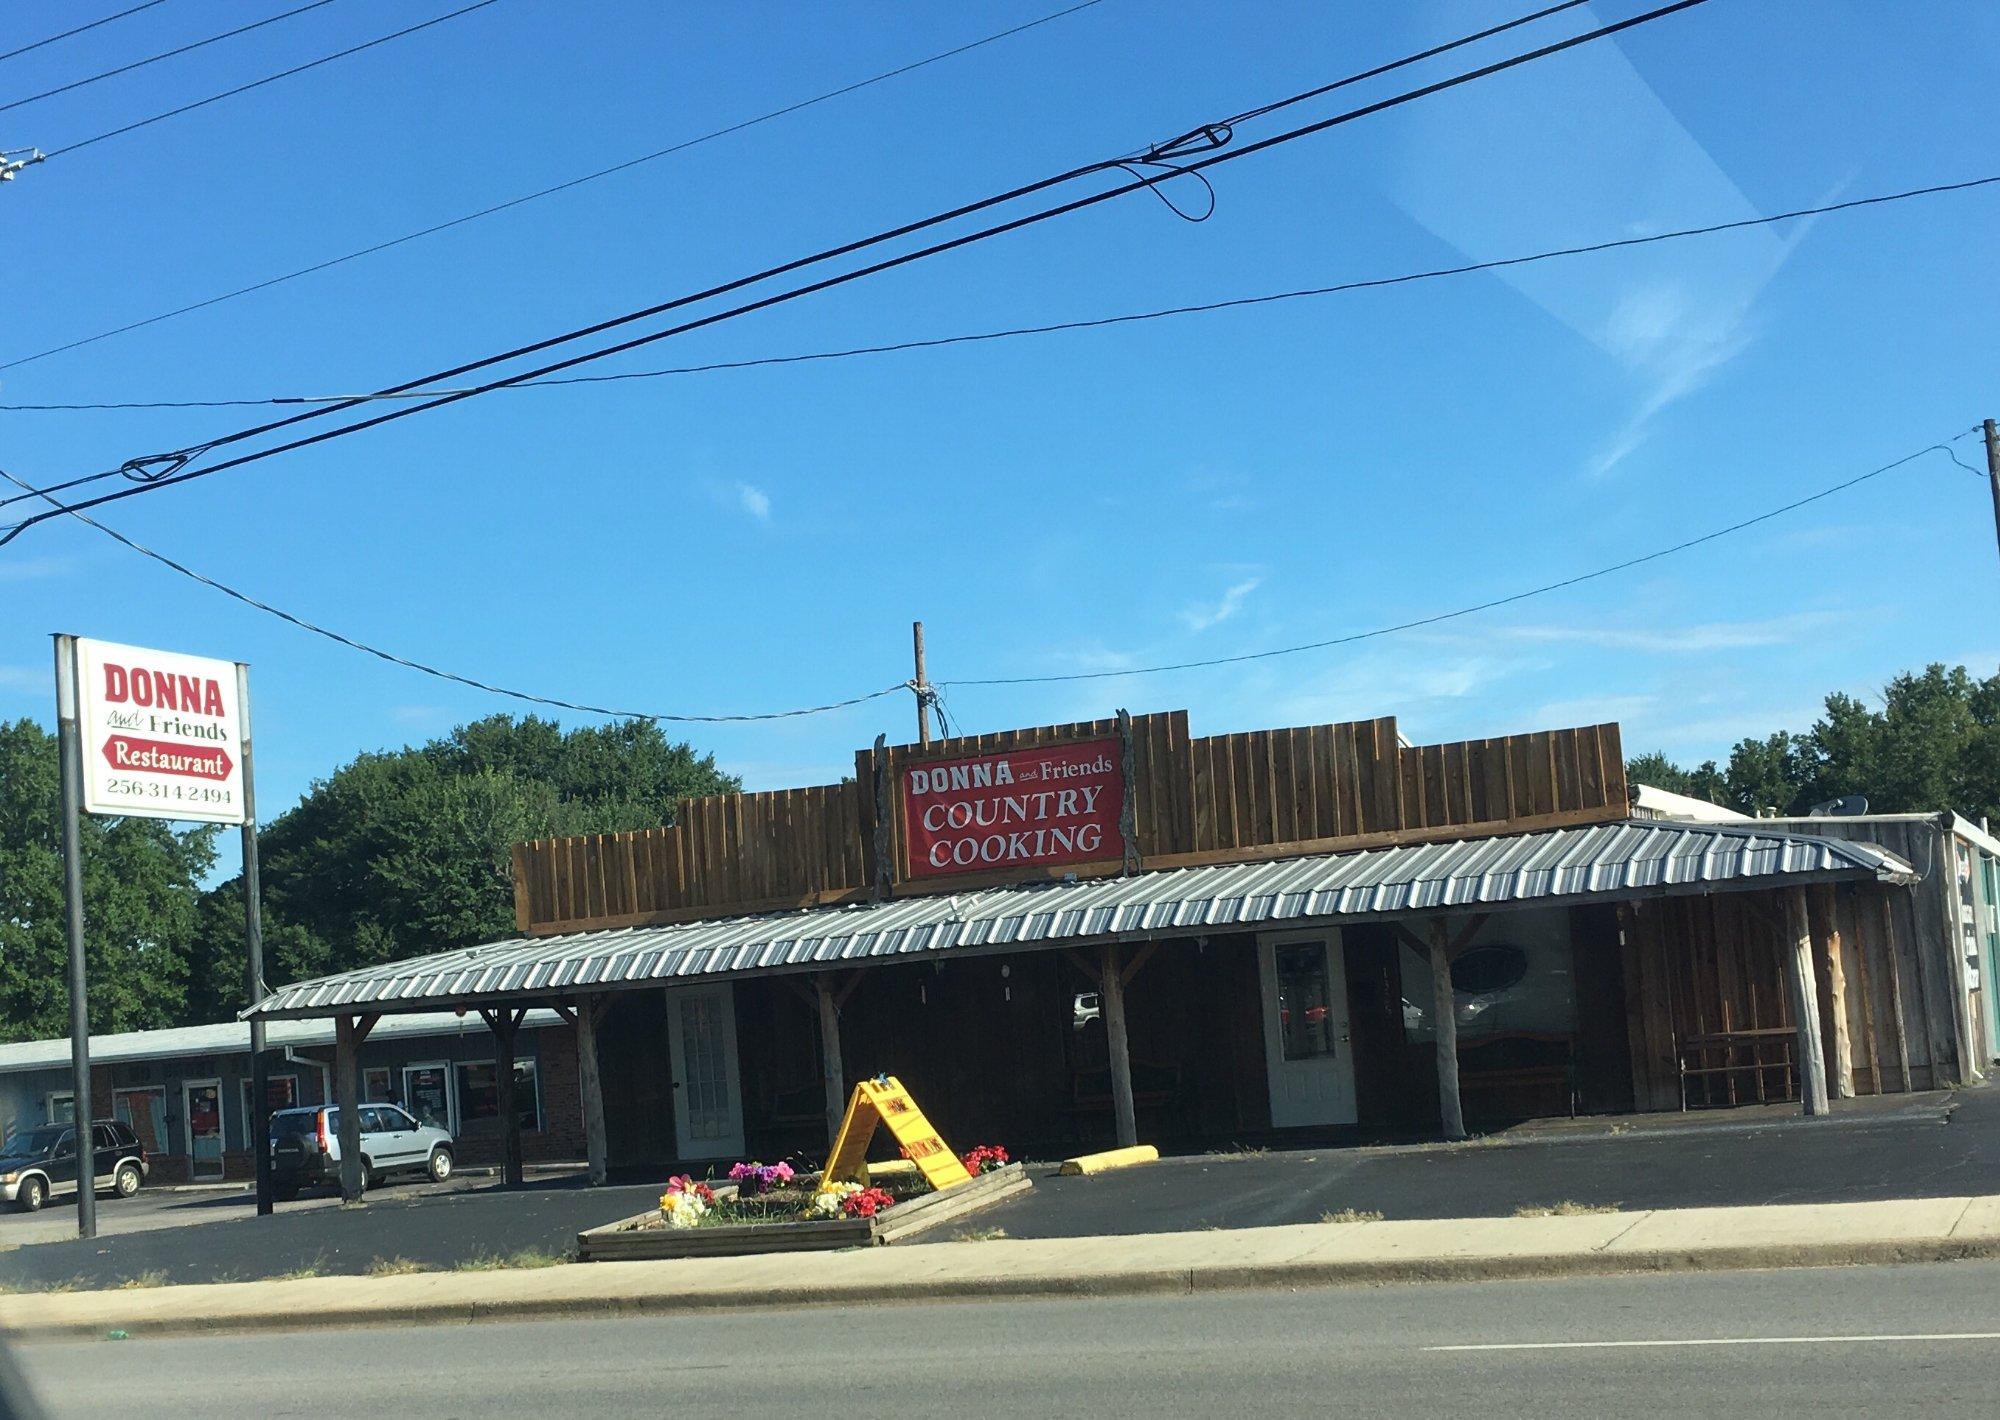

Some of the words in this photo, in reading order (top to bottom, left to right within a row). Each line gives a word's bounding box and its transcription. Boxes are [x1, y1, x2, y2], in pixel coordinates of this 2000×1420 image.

[103, 663, 225, 717] DONNA
[107, 709, 144, 728] and
[150, 715, 228, 741] Friends
[114, 740, 224, 775] Restaurant
[911, 760, 1015, 795] DONNA
[1019, 769, 1038, 781] and
[1040, 755, 1113, 781] Friends
[923, 785, 1103, 832] COUNTRY
[929, 823, 1102, 868] COOKING
